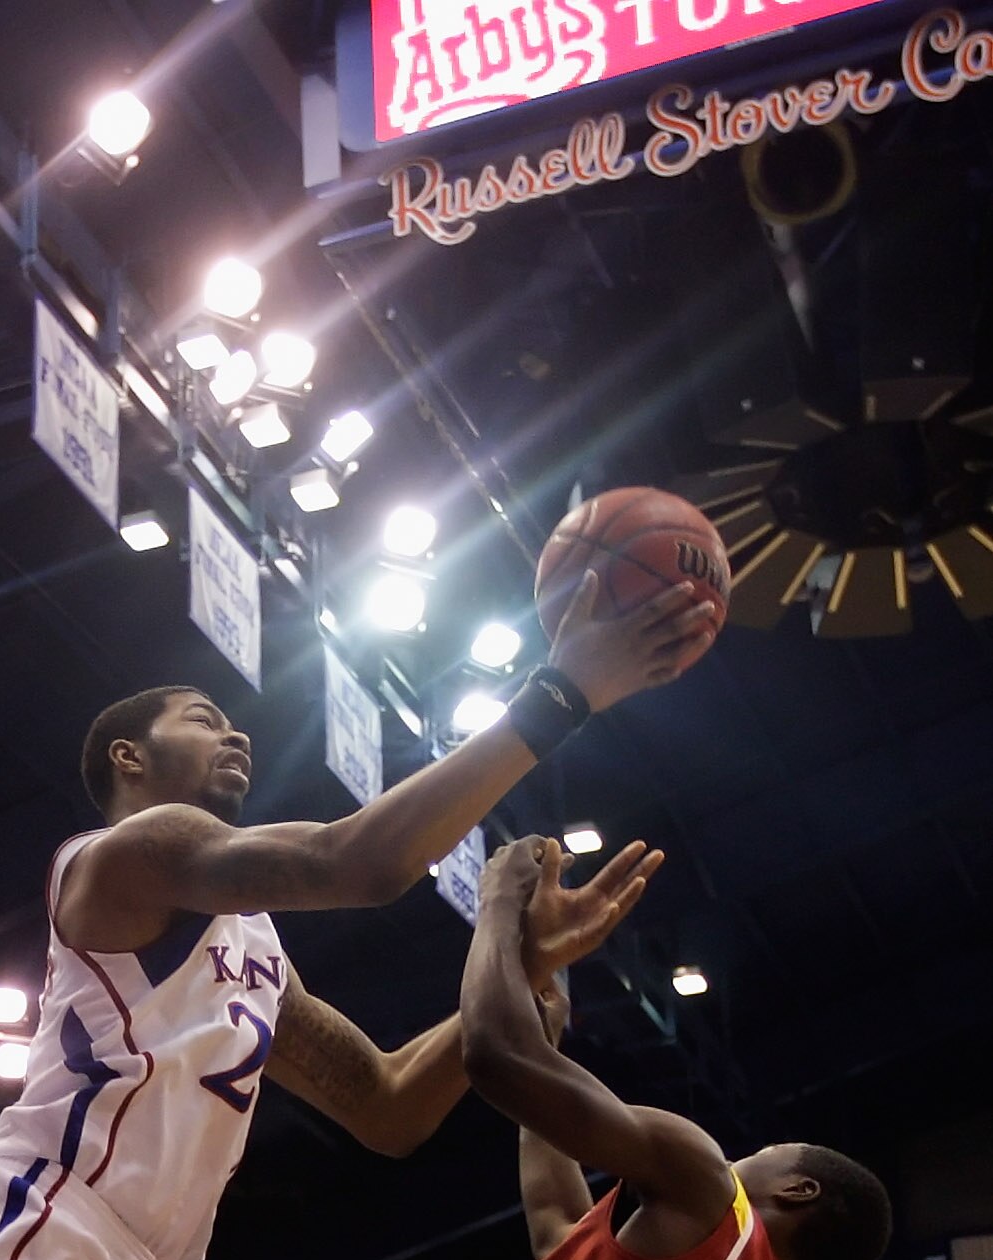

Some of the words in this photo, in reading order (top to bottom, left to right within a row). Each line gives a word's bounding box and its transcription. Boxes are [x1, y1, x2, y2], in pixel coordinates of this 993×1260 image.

[377, 113, 636, 245] Russell
[643, 69, 896, 177] Stover
[199, 1001, 274, 1114] 2
